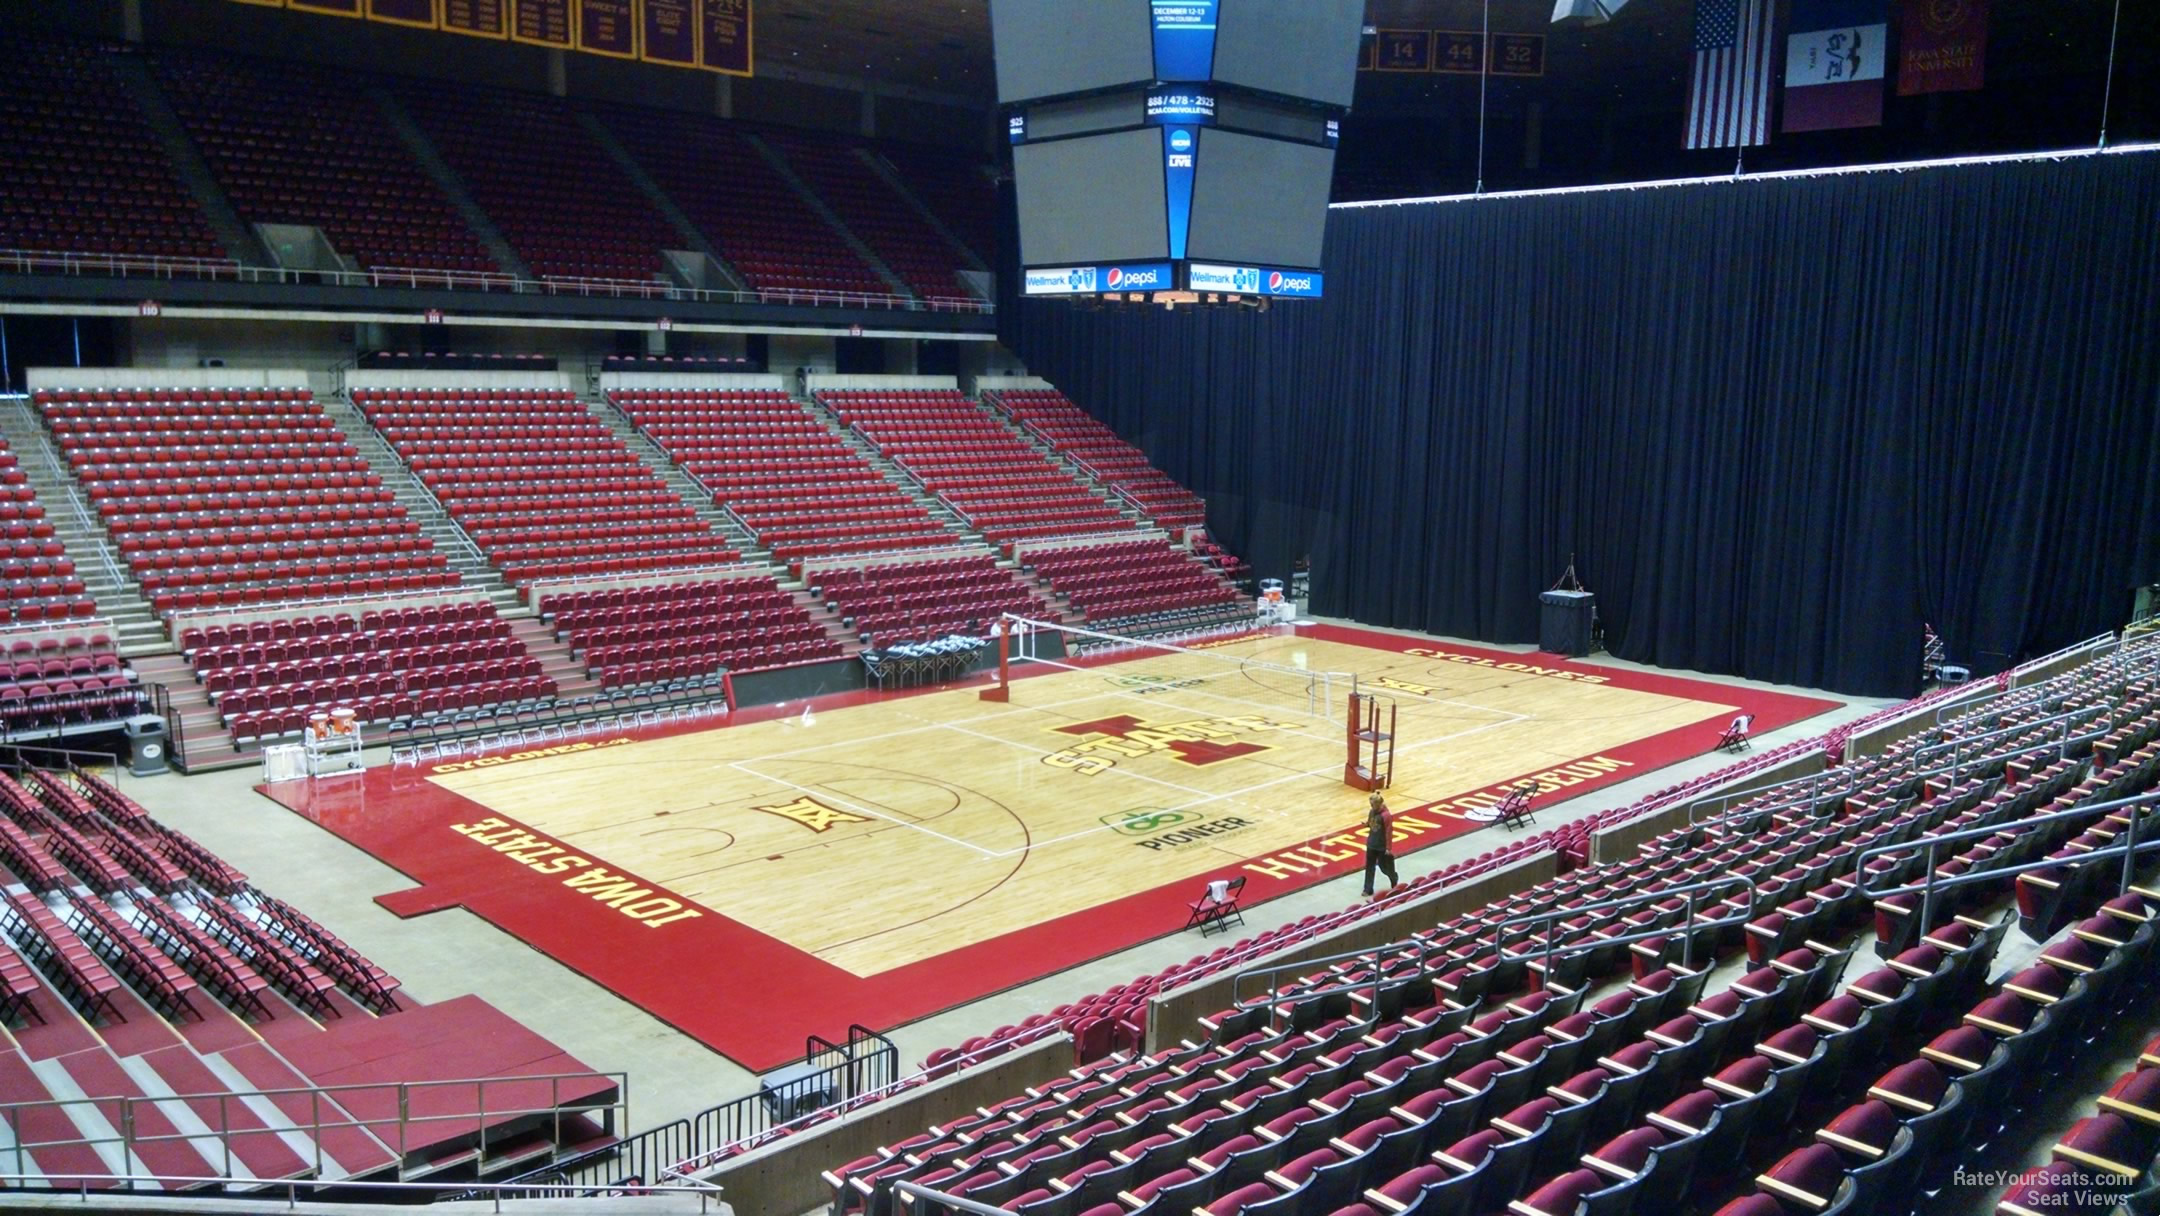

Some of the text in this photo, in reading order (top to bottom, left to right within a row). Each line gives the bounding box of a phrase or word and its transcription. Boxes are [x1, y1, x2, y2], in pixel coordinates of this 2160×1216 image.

[1153, 7, 1188, 16] DECEMBER
[1393, 42, 1413, 58] 14
[1449, 44, 1473, 60] 44
[1506, 46, 1531, 63] 32
[1148, 96, 1163, 107] 888
[1169, 96, 1189, 105] 478
[1195, 96, 1214, 107] 2925
[1169, 158, 1192, 167] LIVE
[1026, 276, 1066, 288] Wellmark
[1124, 269, 1158, 287] pepsi
[1190, 272, 1230, 284] Wellmark
[1283, 276, 1311, 292] pepsi
[143, 306, 158, 316] 110
[1402, 647, 1611, 684] CYCLONES
[1134, 816, 1255, 851] PIONEER
[450, 817, 703, 929] IOWA STATE
